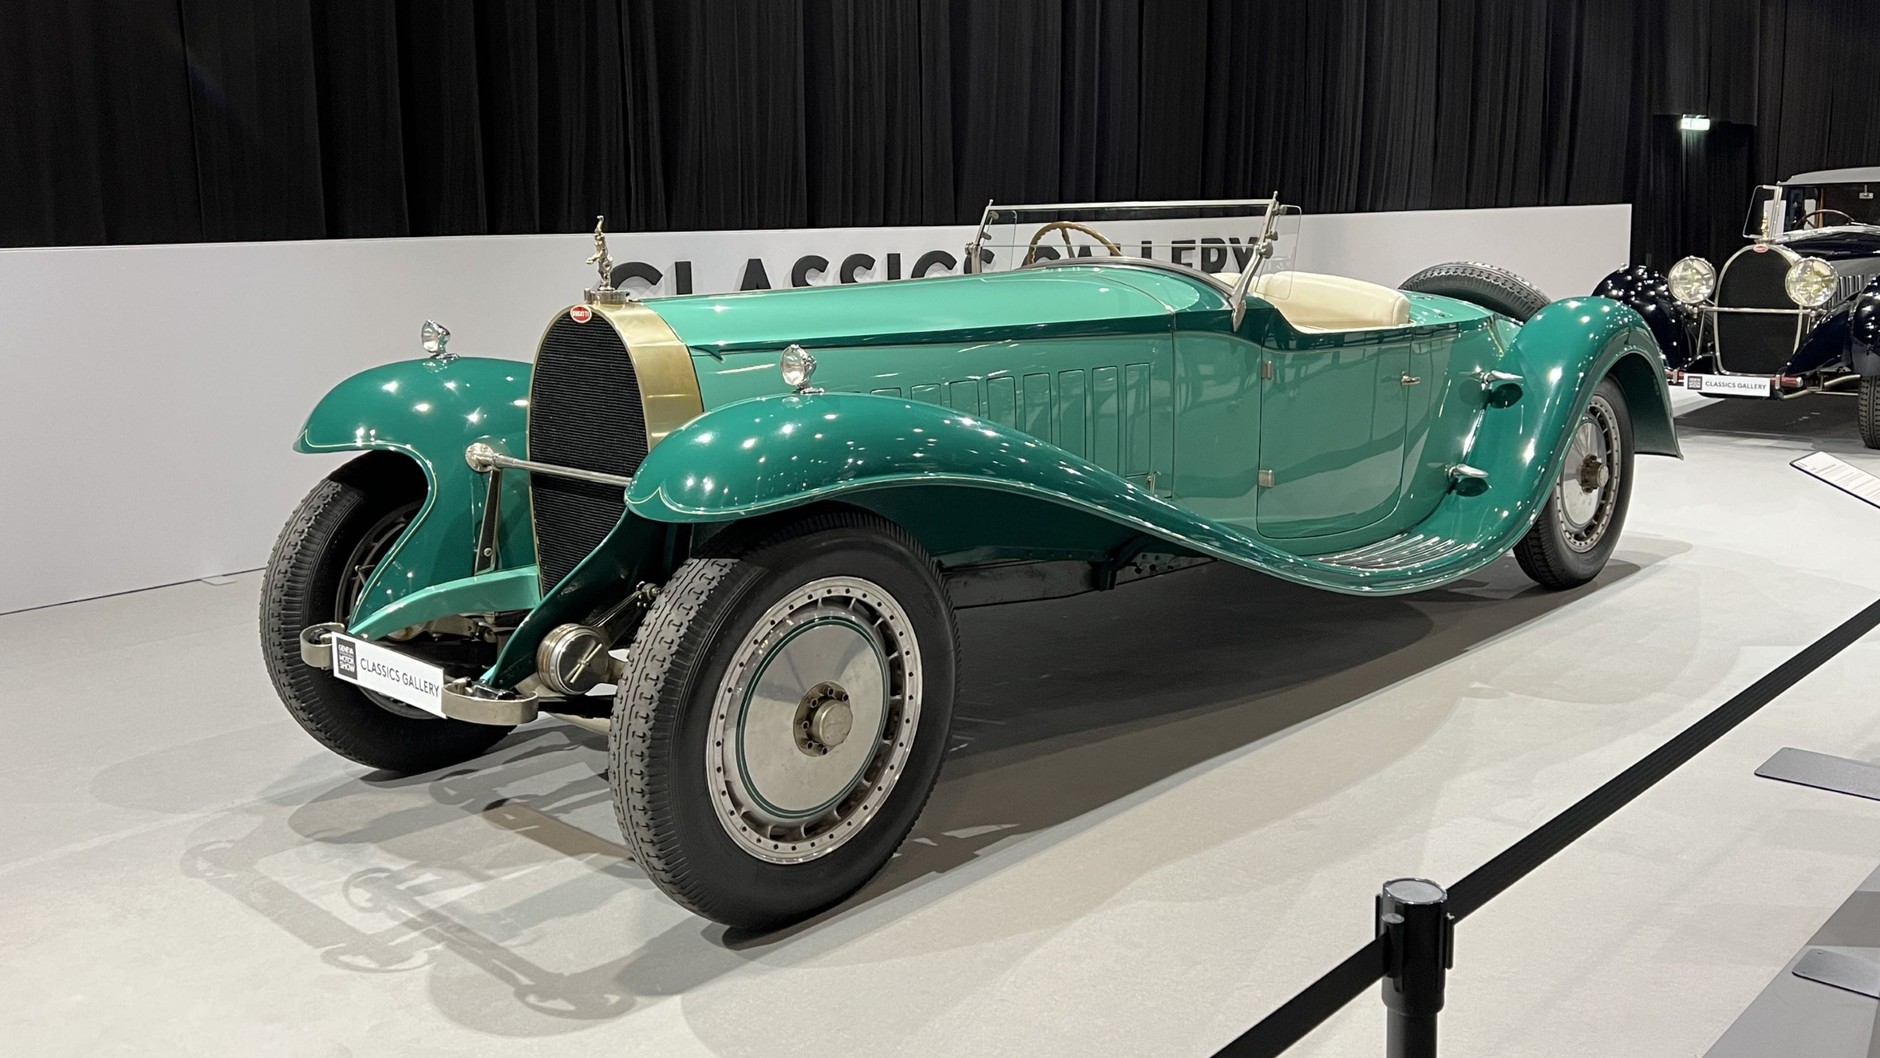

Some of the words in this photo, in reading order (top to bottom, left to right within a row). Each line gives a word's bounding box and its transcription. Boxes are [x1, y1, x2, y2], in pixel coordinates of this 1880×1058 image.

[1705, 381, 1736, 389] CLASSICS
[1737, 382, 1767, 390] GALLERY
[360, 658, 400, 682] CLASSICS
[402, 673, 439, 697] GALLERY
